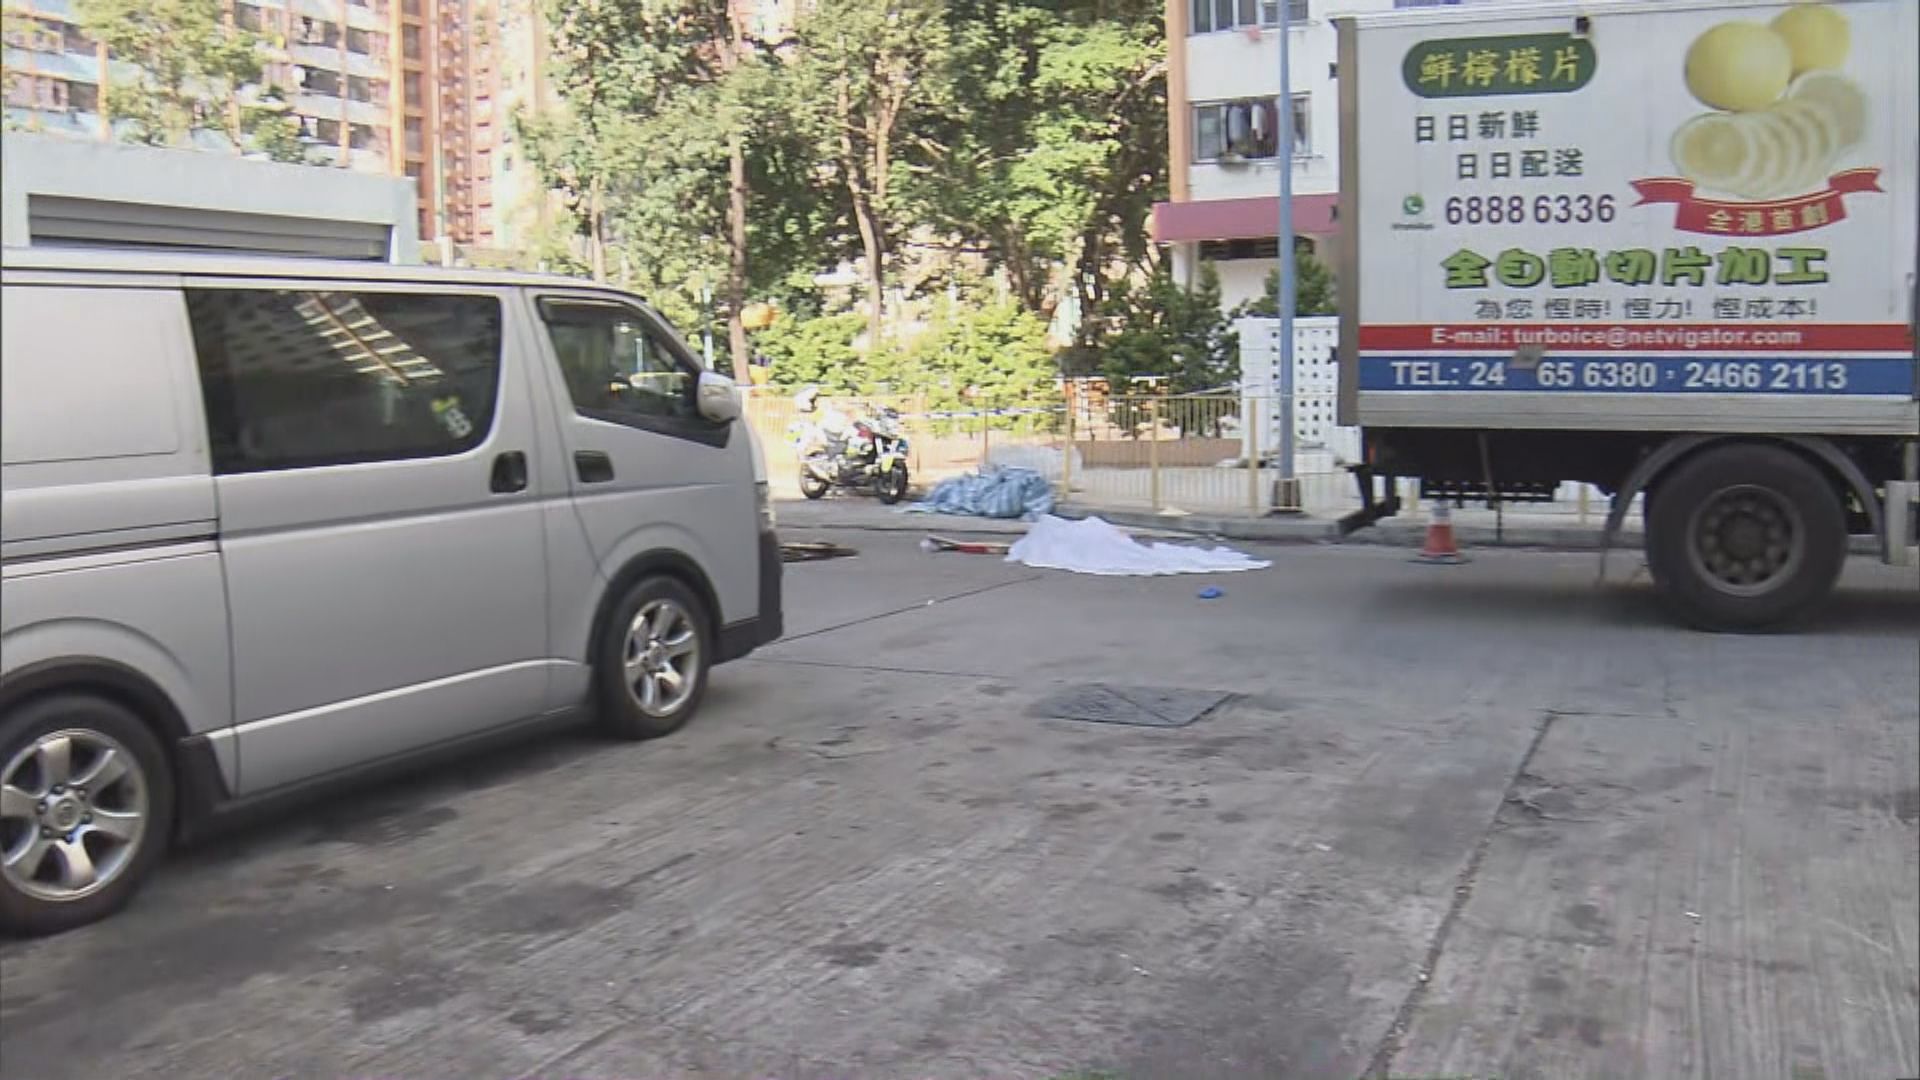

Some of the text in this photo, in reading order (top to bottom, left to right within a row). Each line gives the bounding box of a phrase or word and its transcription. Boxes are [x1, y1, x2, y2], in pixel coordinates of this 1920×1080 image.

[1415, 110, 1542, 143] 日日新鮮
[1457, 148, 1584, 179] 日日配送
[1446, 193, 1616, 225] 6888 6336
[1440, 246, 1829, 288] 全自動切片加工
[1474, 299, 1533, 320] 為您
[1431, 326, 1801, 347] E-mail: turboice@netvigator.com
[1390, 361, 1459, 386] TEL:
[1469, 361, 1506, 386] 24
[1536, 362, 1575, 387] 65
[1583, 362, 1656, 388] 6380
[1684, 363, 1761, 388] 2466
[1769, 363, 1847, 390] 2113
